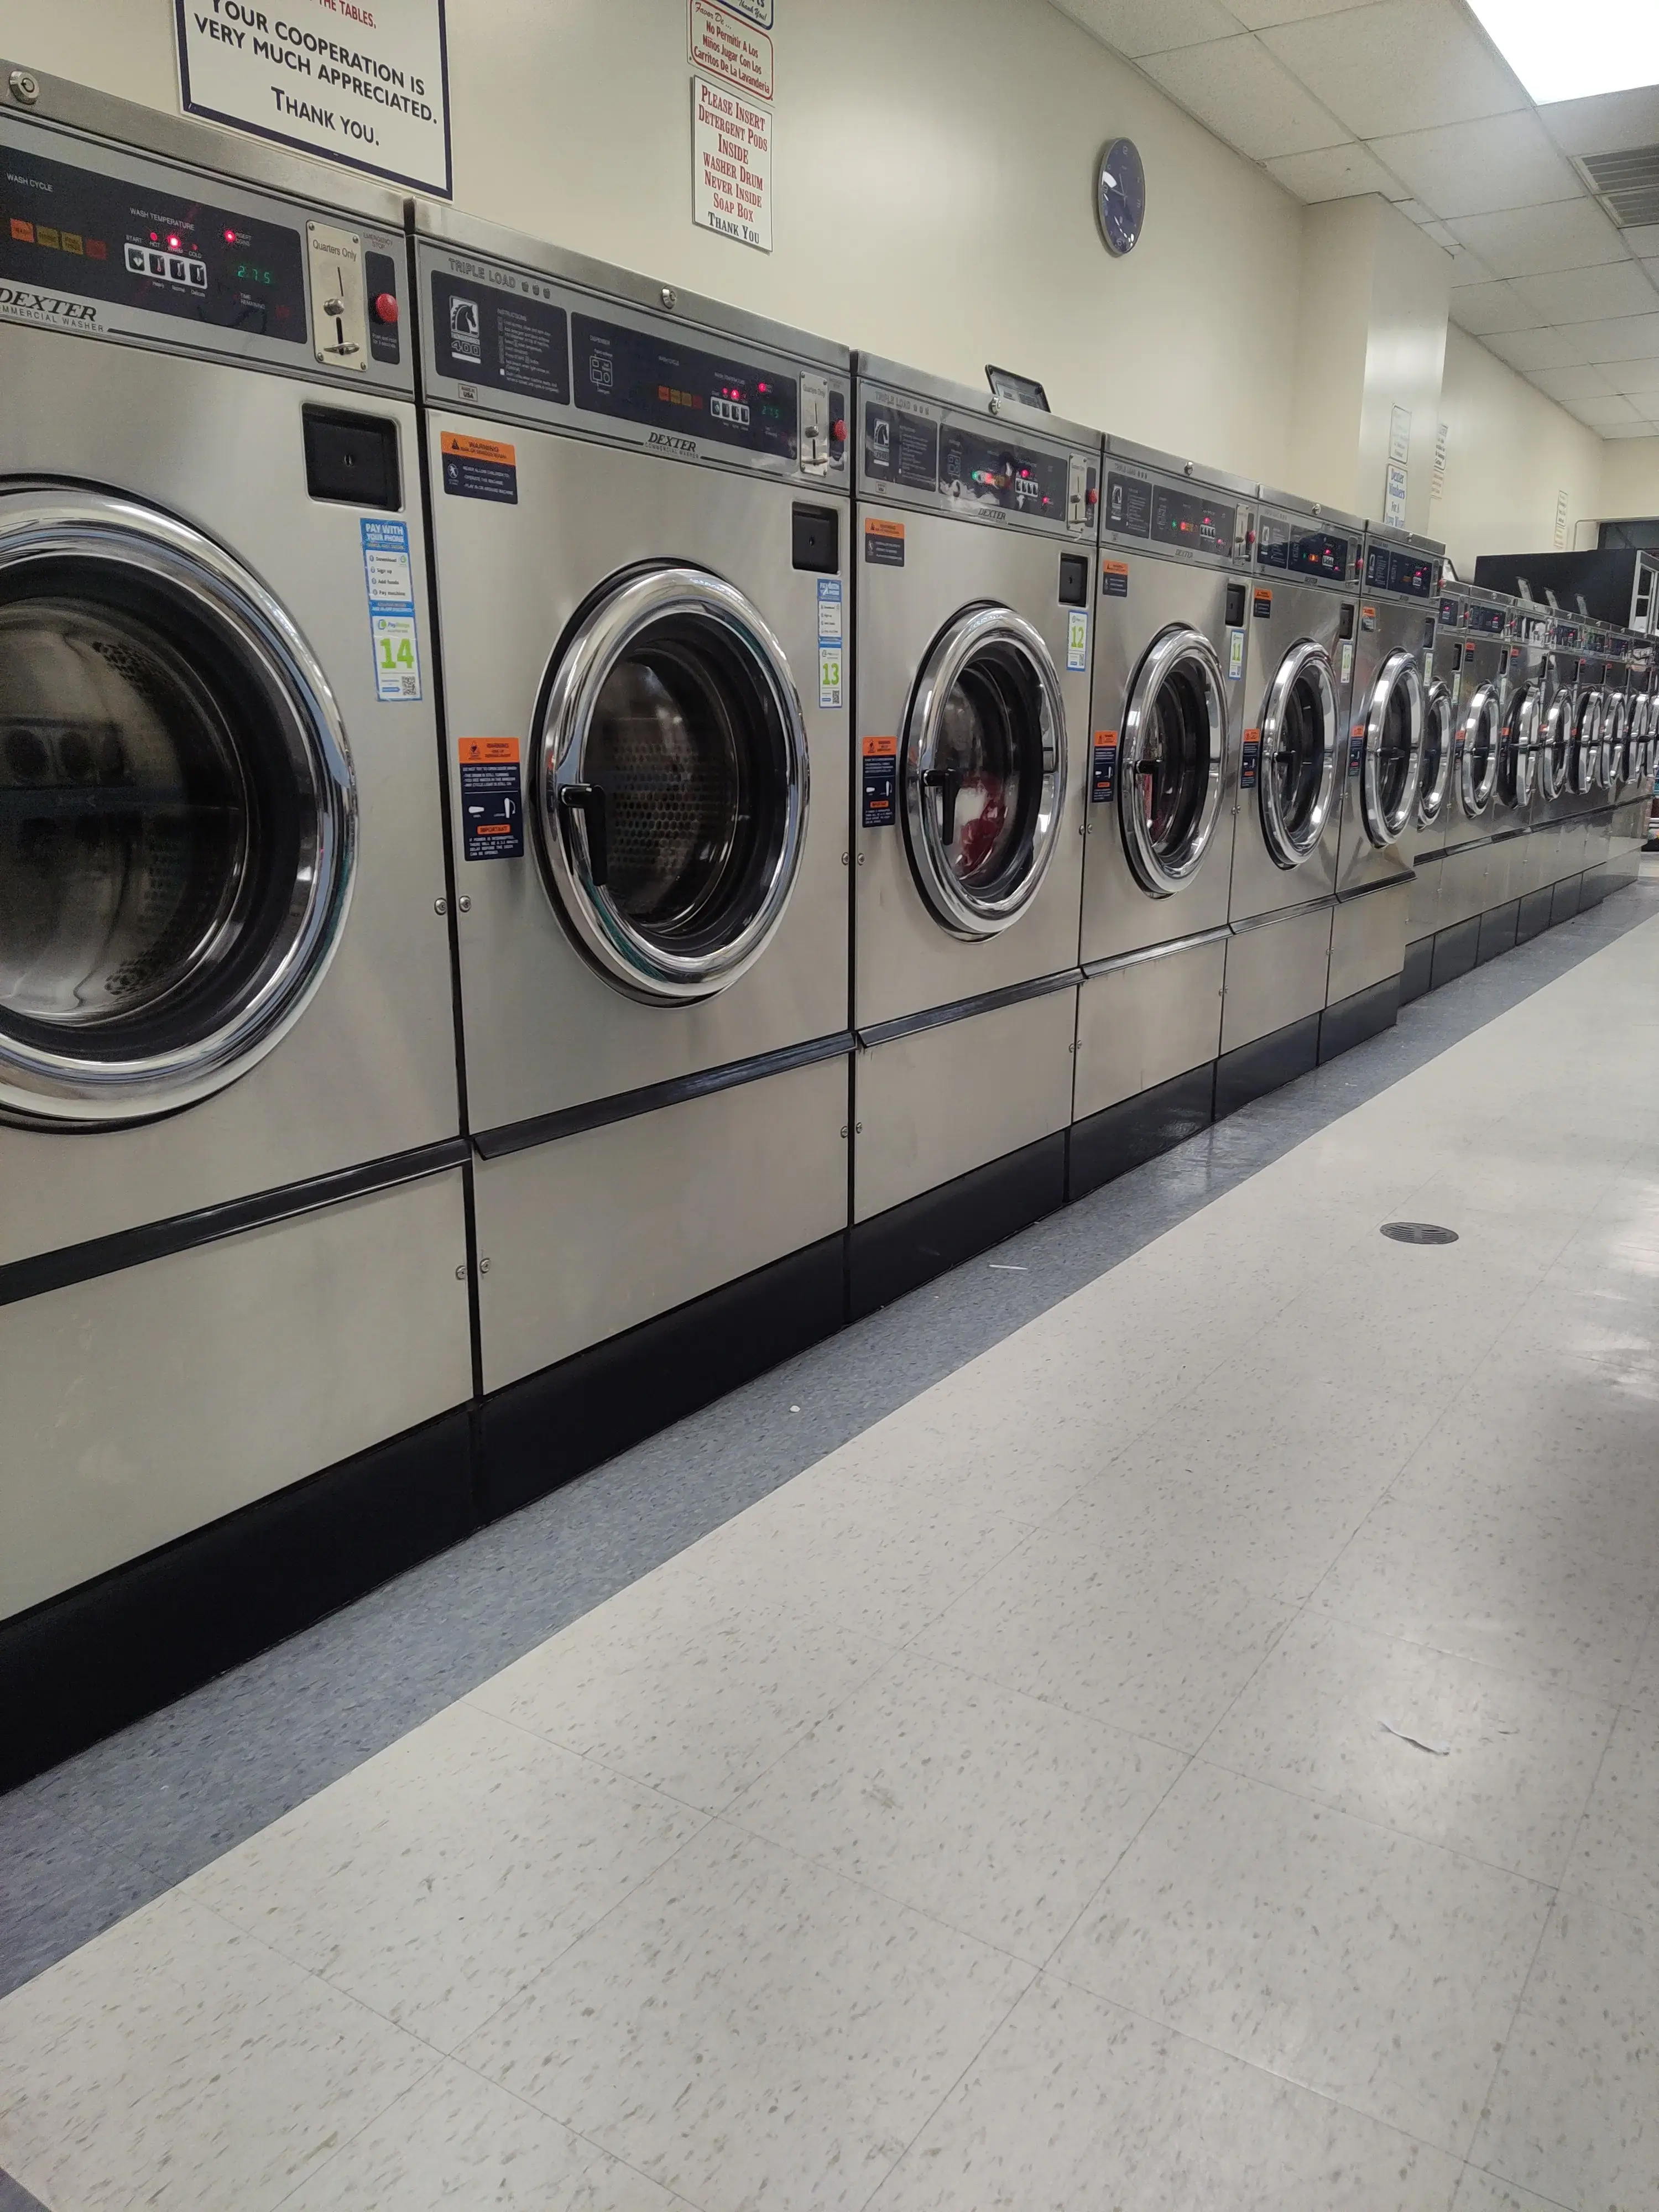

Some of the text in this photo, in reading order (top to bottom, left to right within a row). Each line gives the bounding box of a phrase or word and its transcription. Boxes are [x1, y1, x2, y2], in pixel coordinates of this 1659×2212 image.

[339, 0, 377, 29] TABLES.
[695, 2, 714, 19] Favor
[212, 0, 425, 96] YOUR COOPERATION IS
[706, 20, 758, 58] No Permitir A Los
[694, 46, 719, 67] Carritos
[721, 59, 728, 72] De
[730, 64, 737, 77] La
[703, 34, 761, 75] Niños Jugar Con Los
[194, 13, 438, 124] VERY MUCH APPRECIATED.
[340, 116, 380, 146] YOU.
[703, 152, 737, 179] WASHER
[6, 173, 53, 192] WASH CYCLE
[129, 207, 195, 231] WASH TEMPERATURE
[126, 235, 143, 243] START
[188, 251, 202, 259] COLD
[312, 239, 357, 262] Quarters Only
[448, 257, 516, 288] TRIPLE LOAD
[0, 287, 97, 322] DEXTER
[0, 305, 104, 332] MMERCIAL WASHER
[648, 432, 696, 452] DEXTER
[978, 508, 1006, 520] DEXTER
[366, 523, 404, 535] PAY WITH
[1071, 626, 1084, 648] 12
[380, 638, 414, 669] 14
[1232, 643, 1241, 661] 11
[822, 663, 839, 685] 13
